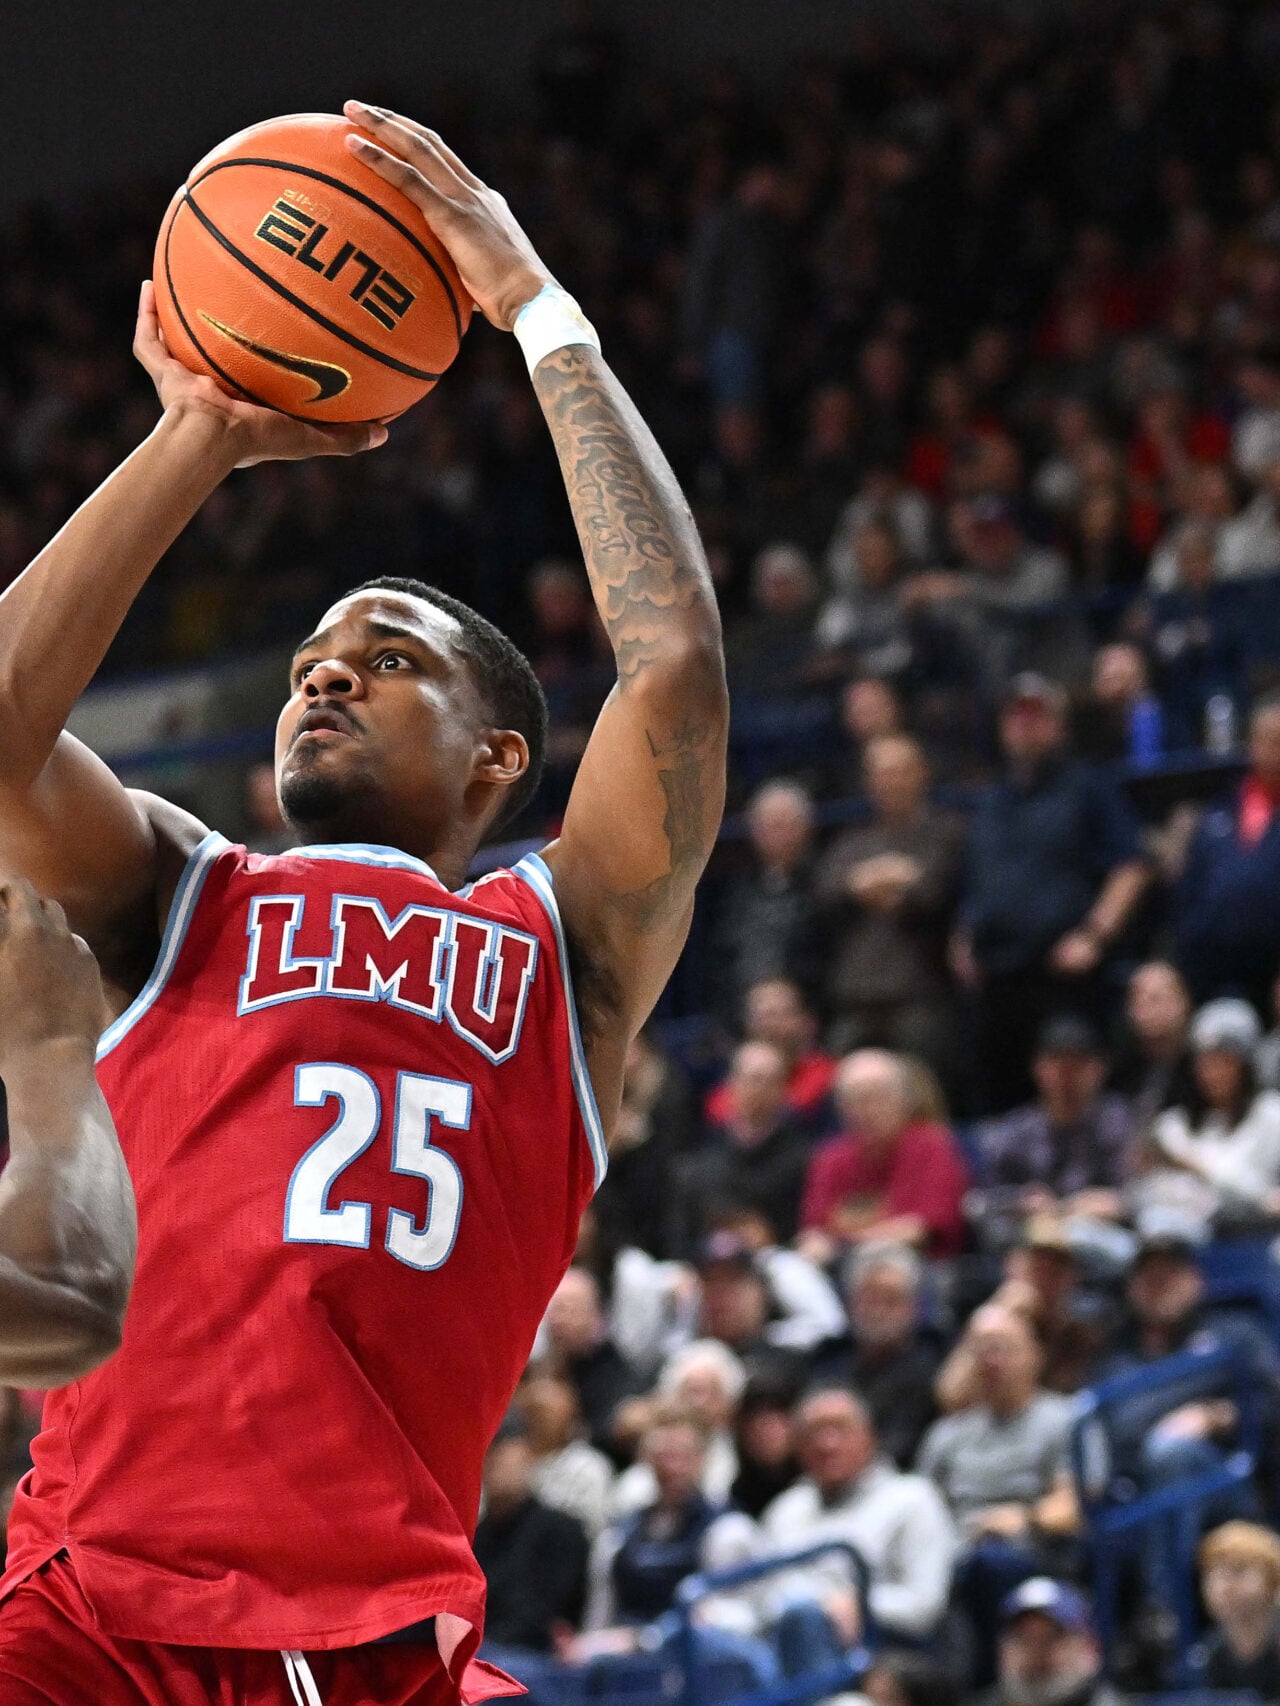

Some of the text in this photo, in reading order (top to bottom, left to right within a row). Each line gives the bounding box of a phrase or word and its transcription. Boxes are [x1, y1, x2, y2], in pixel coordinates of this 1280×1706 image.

[254, 198, 417, 332] ELITE
[236, 893, 540, 1066] LMU
[283, 1061, 473, 1271] 25
